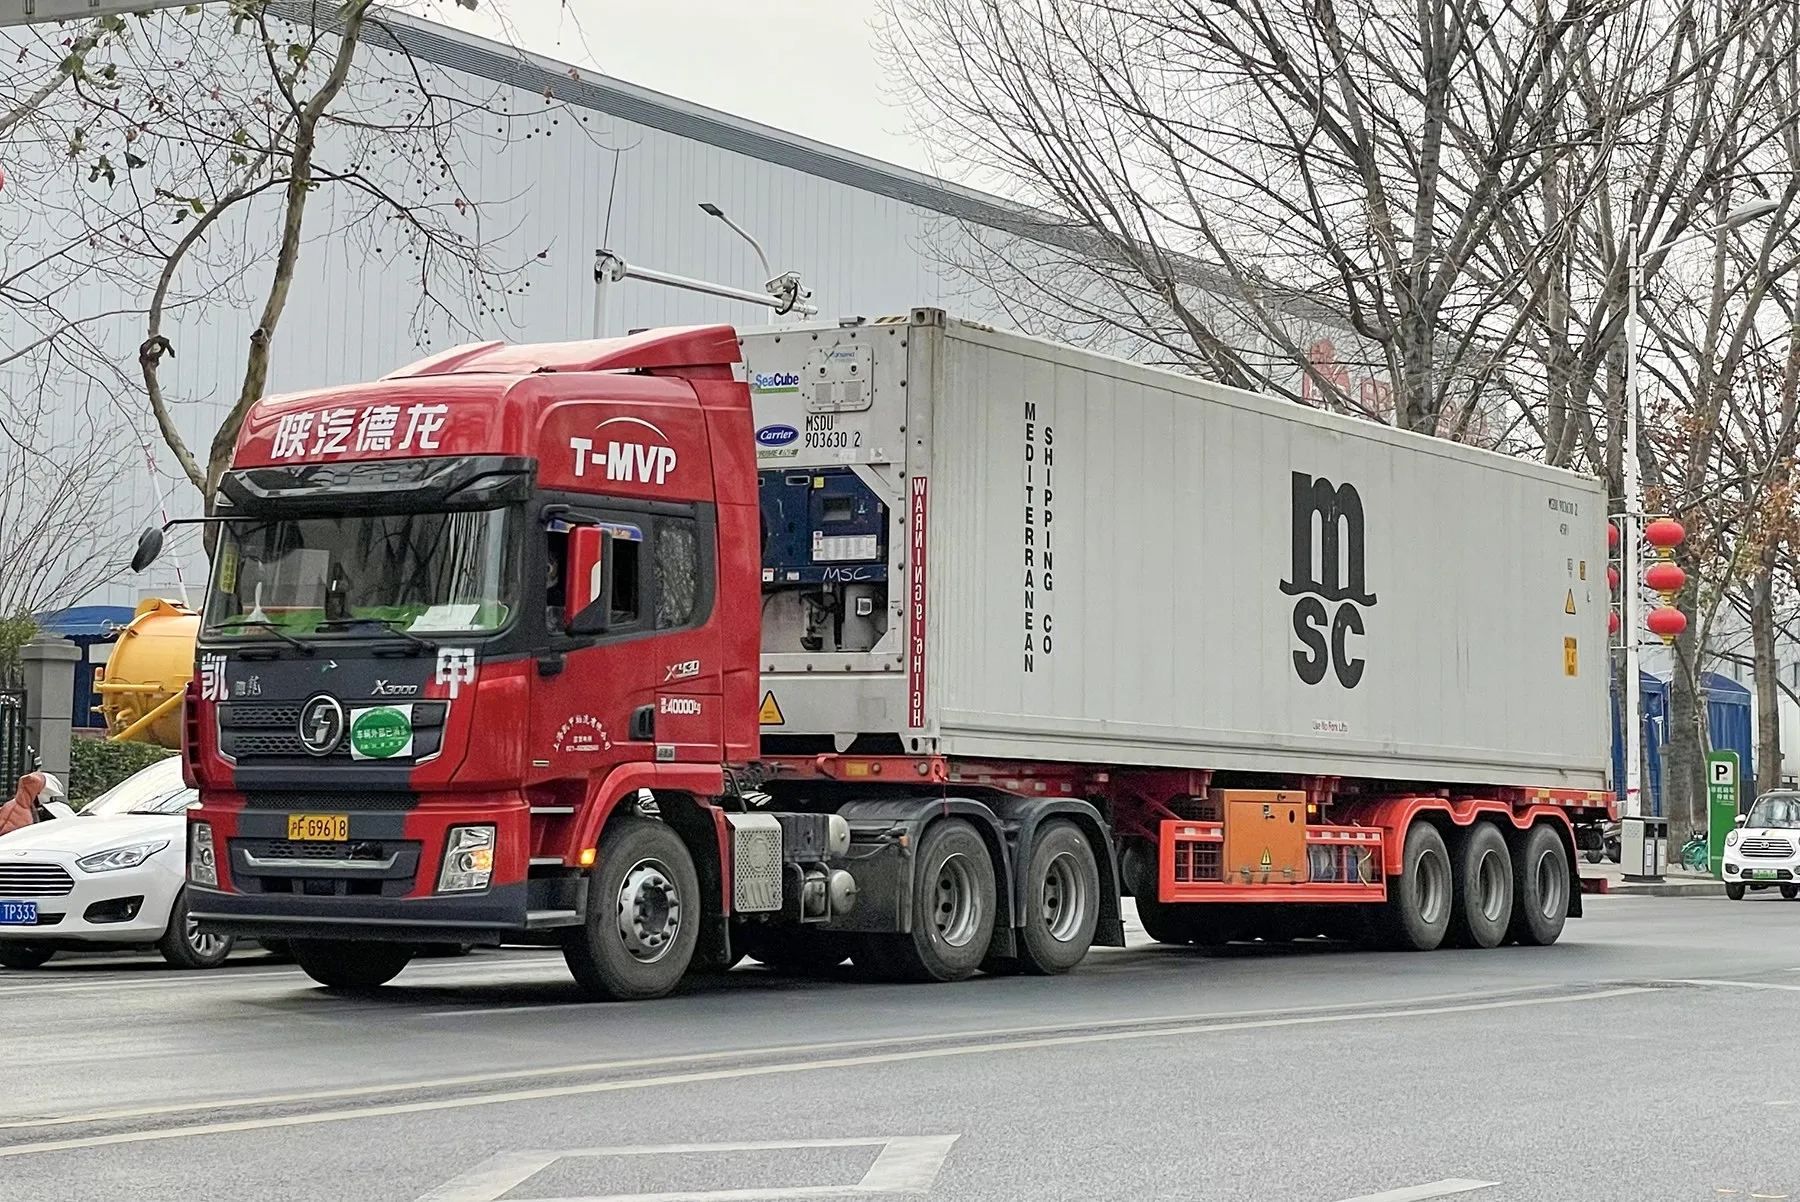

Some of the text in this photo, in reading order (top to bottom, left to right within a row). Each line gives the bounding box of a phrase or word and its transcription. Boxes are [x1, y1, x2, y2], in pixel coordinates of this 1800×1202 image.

[756, 373, 799, 388] SeaCube
[270, 403, 448, 459] 陕汽德龙
[806, 415, 833, 431] MSDU
[760, 430, 793, 440] Carrier
[805, 431, 861, 448] 903630 2
[570, 437, 677, 485] T-MVP
[1024, 402, 1036, 672] MEDITERRANEAN
[1043, 426, 1053, 654] SHIPPING CO
[822, 567, 871, 582] MSC
[371, 680, 417, 695] X3000
[1716, 764, 1728, 781] P
